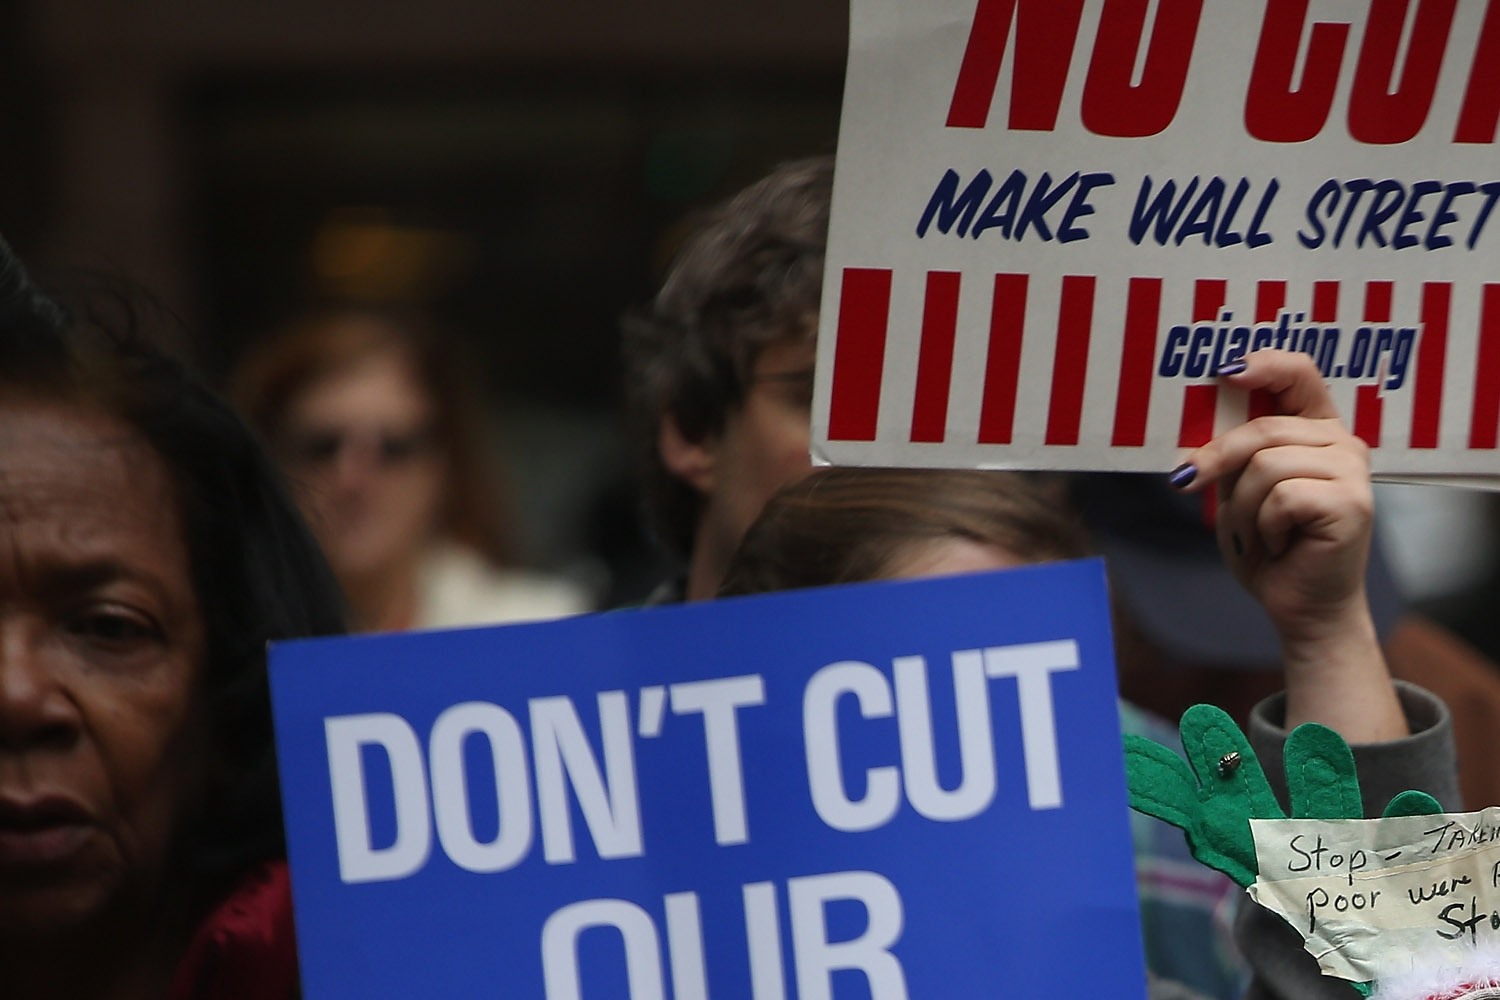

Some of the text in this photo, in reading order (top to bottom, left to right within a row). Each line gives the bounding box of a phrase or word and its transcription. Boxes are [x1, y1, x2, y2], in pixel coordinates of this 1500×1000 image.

[916, 168, 1115, 245] MAKE
[1128, 174, 1280, 250] WALL
[324, 638, 1081, 884] DON'T CUT
[1288, 834, 1367, 886] Stop
